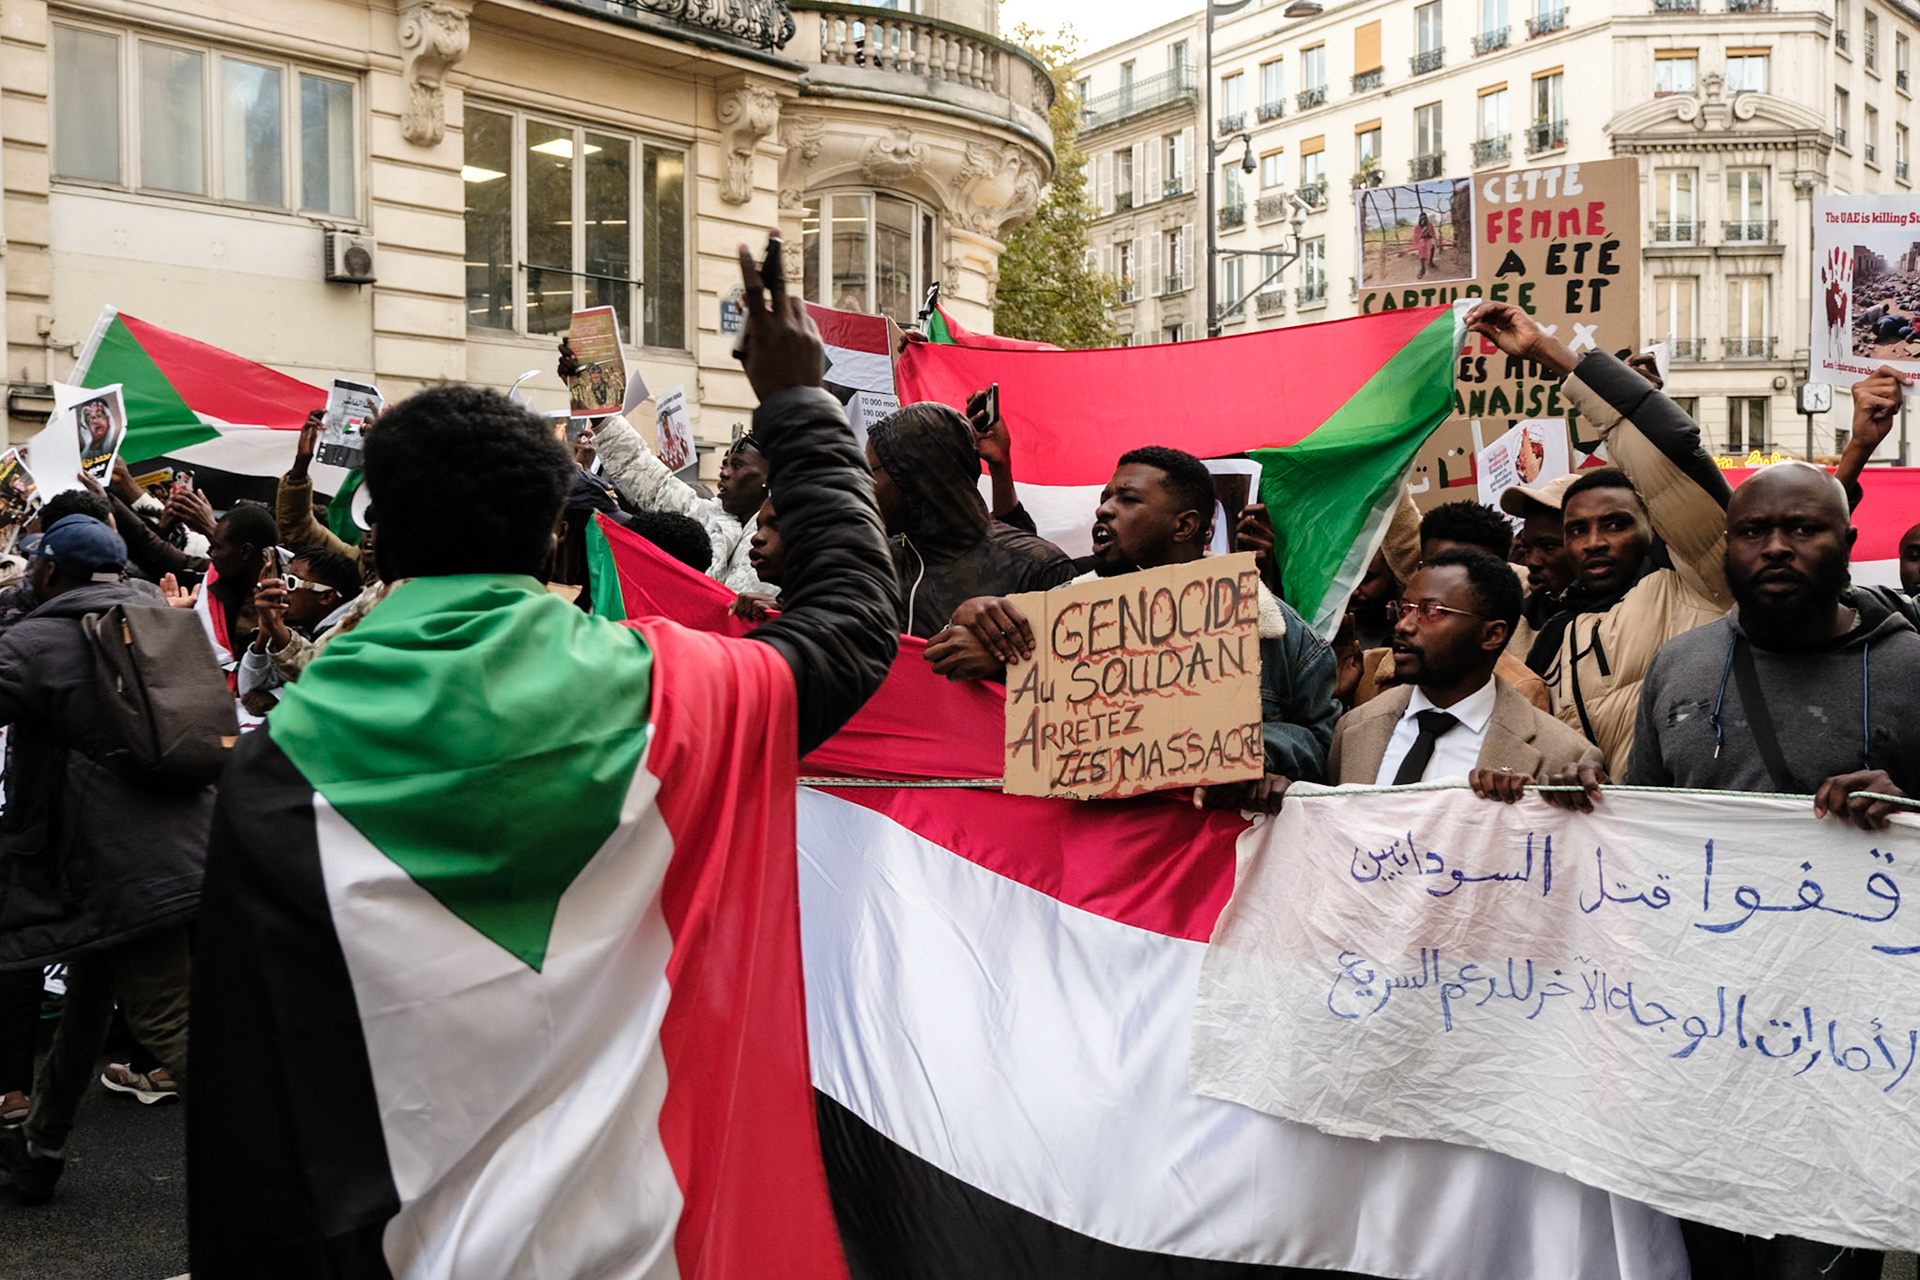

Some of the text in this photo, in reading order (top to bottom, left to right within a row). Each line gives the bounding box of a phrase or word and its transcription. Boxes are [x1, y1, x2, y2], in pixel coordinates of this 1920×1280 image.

[1483, 164, 1584, 204] CETTE
[1487, 201, 1606, 244] FEMME
[1825, 212, 1839, 223] The
[1841, 212, 1860, 223] UAE
[1862, 212, 1870, 223] is
[1872, 212, 1908, 226] killing
[1496, 231, 1621, 277] A ÉTÉ
[1566, 277, 1610, 313] ET
[1457, 356, 1488, 383] ES
[1858, 366, 1877, 375] arabe
[861, 397, 868, 405] 70
[870, 398, 882, 406] 000
[1051, 571, 1260, 660] GENOCIDE
[1067, 637, 1248, 704] SOUDAN
[1010, 706, 1144, 772] ARRETEZ
[1579, 846, 1671, 913] قتل
